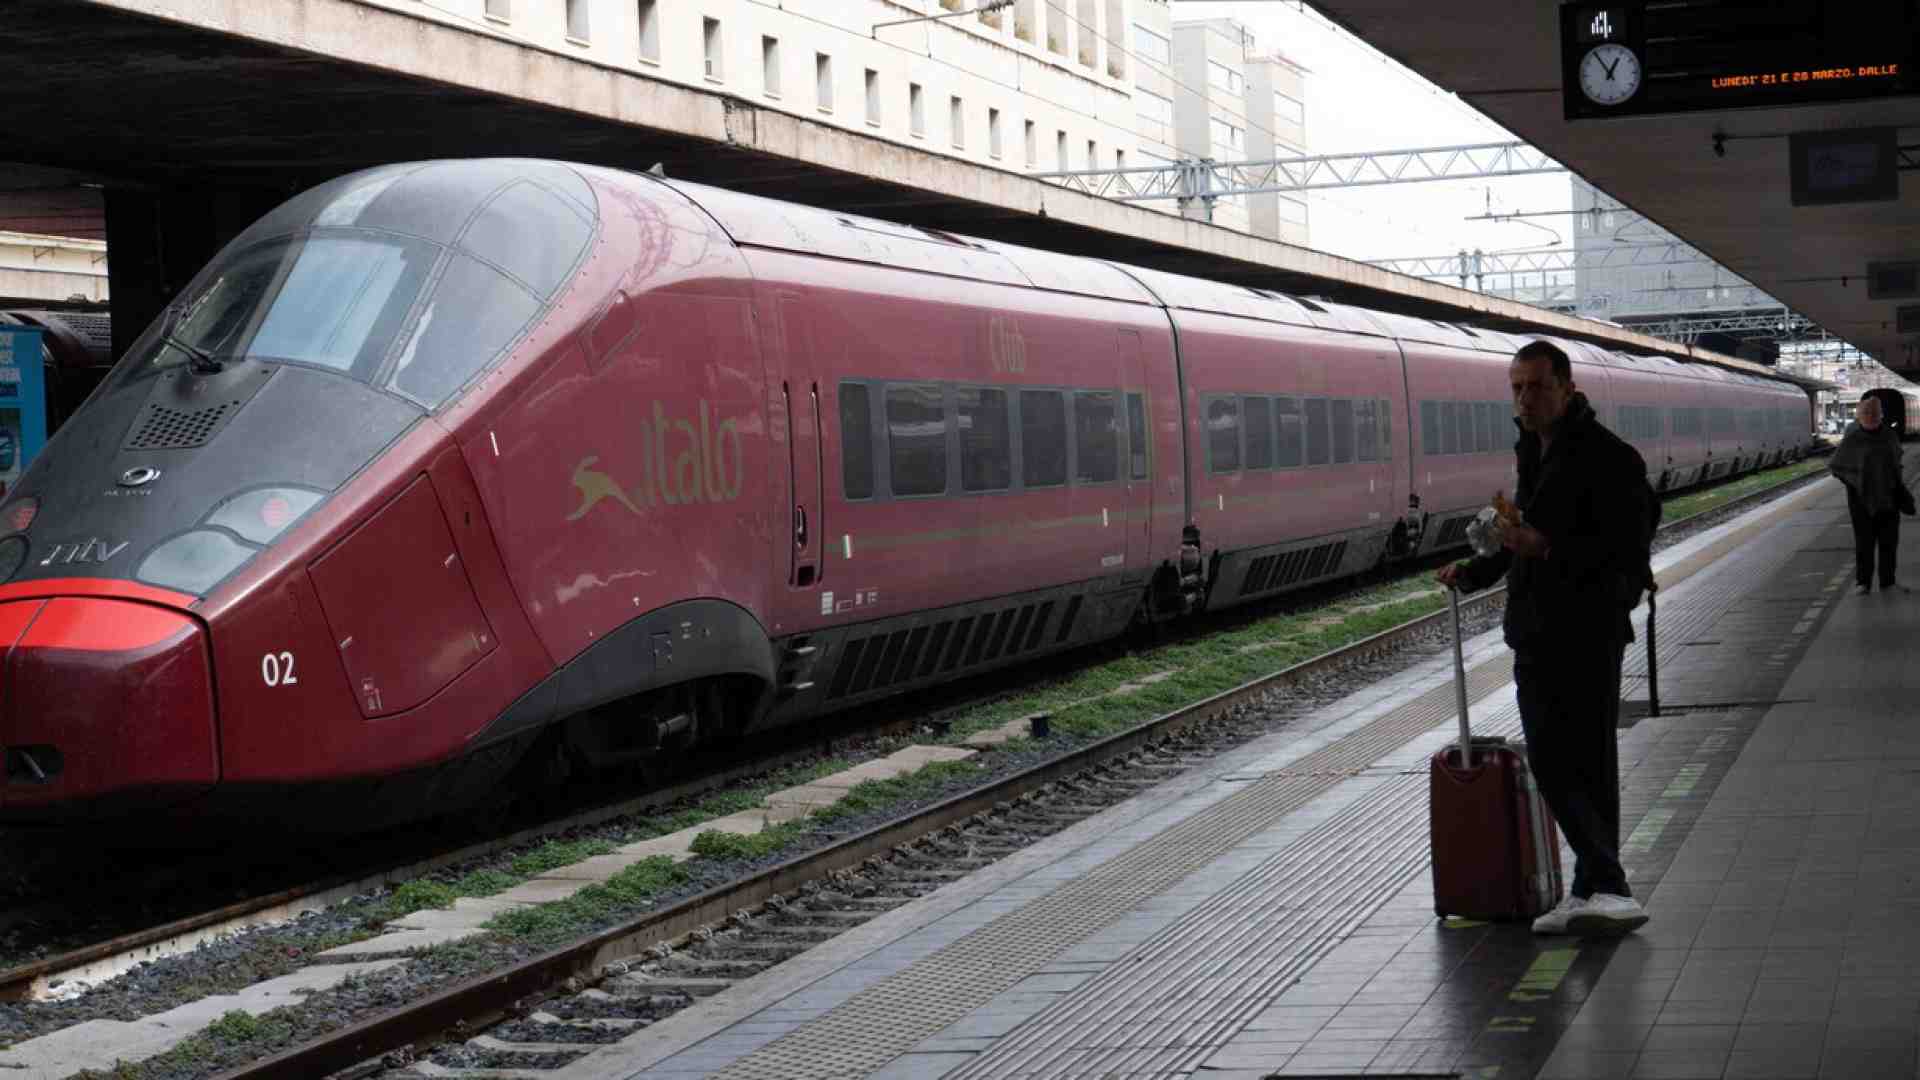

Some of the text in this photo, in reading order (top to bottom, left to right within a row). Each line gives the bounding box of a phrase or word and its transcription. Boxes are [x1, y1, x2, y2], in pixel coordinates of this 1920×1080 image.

[1762, 73, 1776, 84] 21
[1781, 73, 1789, 82] E
[1858, 64, 1898, 77] DALLE
[262, 651, 298, 687] 02
